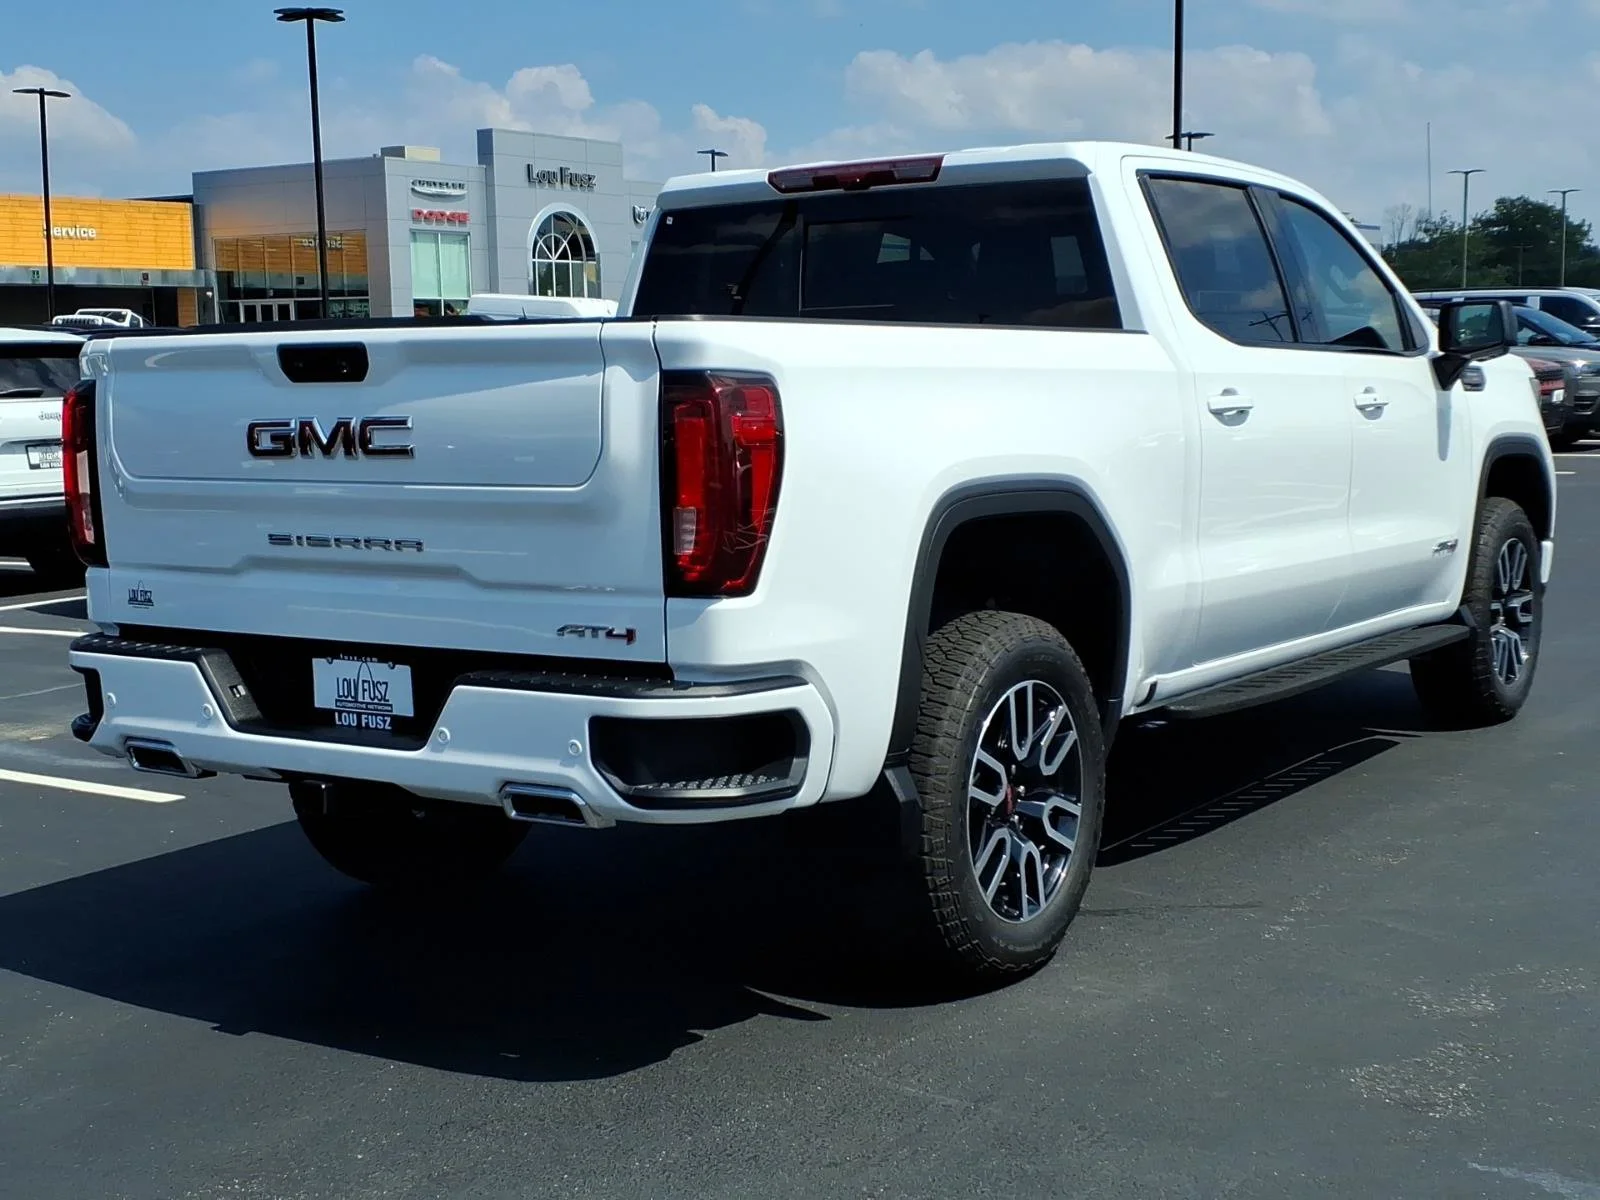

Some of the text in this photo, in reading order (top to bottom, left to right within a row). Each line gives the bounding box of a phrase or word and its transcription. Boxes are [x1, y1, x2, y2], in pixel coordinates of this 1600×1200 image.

[526, 163, 597, 190] Lou Fusz
[412, 208, 470, 225] DODGE
[247, 416, 416, 459] GMC
[267, 533, 425, 552] SIERRA
[556, 623, 637, 646] AT4
[336, 677, 390, 702] LOU FUSZ
[335, 711, 392, 730] LOU FUSZ
